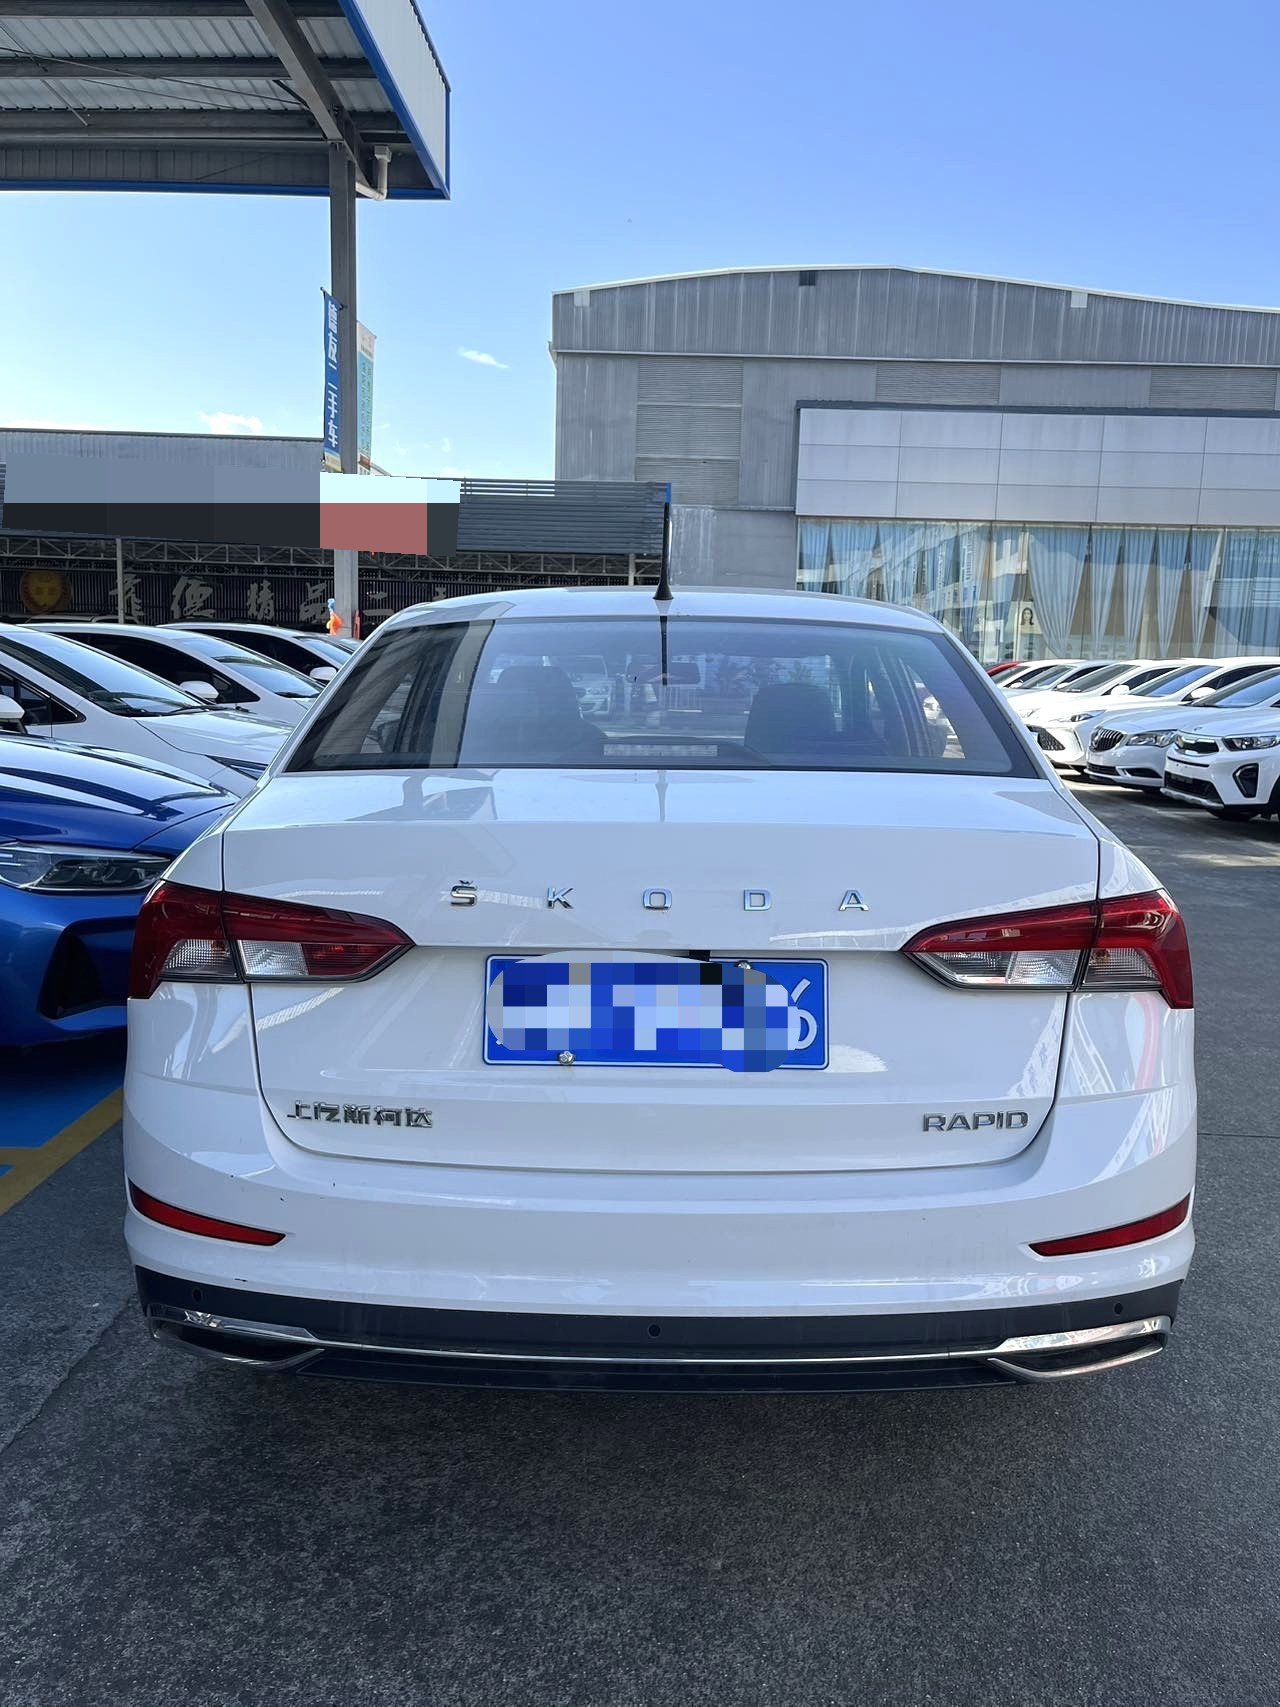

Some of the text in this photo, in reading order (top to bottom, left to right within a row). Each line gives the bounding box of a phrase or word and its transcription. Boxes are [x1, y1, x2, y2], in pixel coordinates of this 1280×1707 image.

[450, 879, 870, 912] ŠKODA
[287, 1100, 433, 1128] 上汽斯柯达
[922, 1111, 1029, 1132] RAPID
